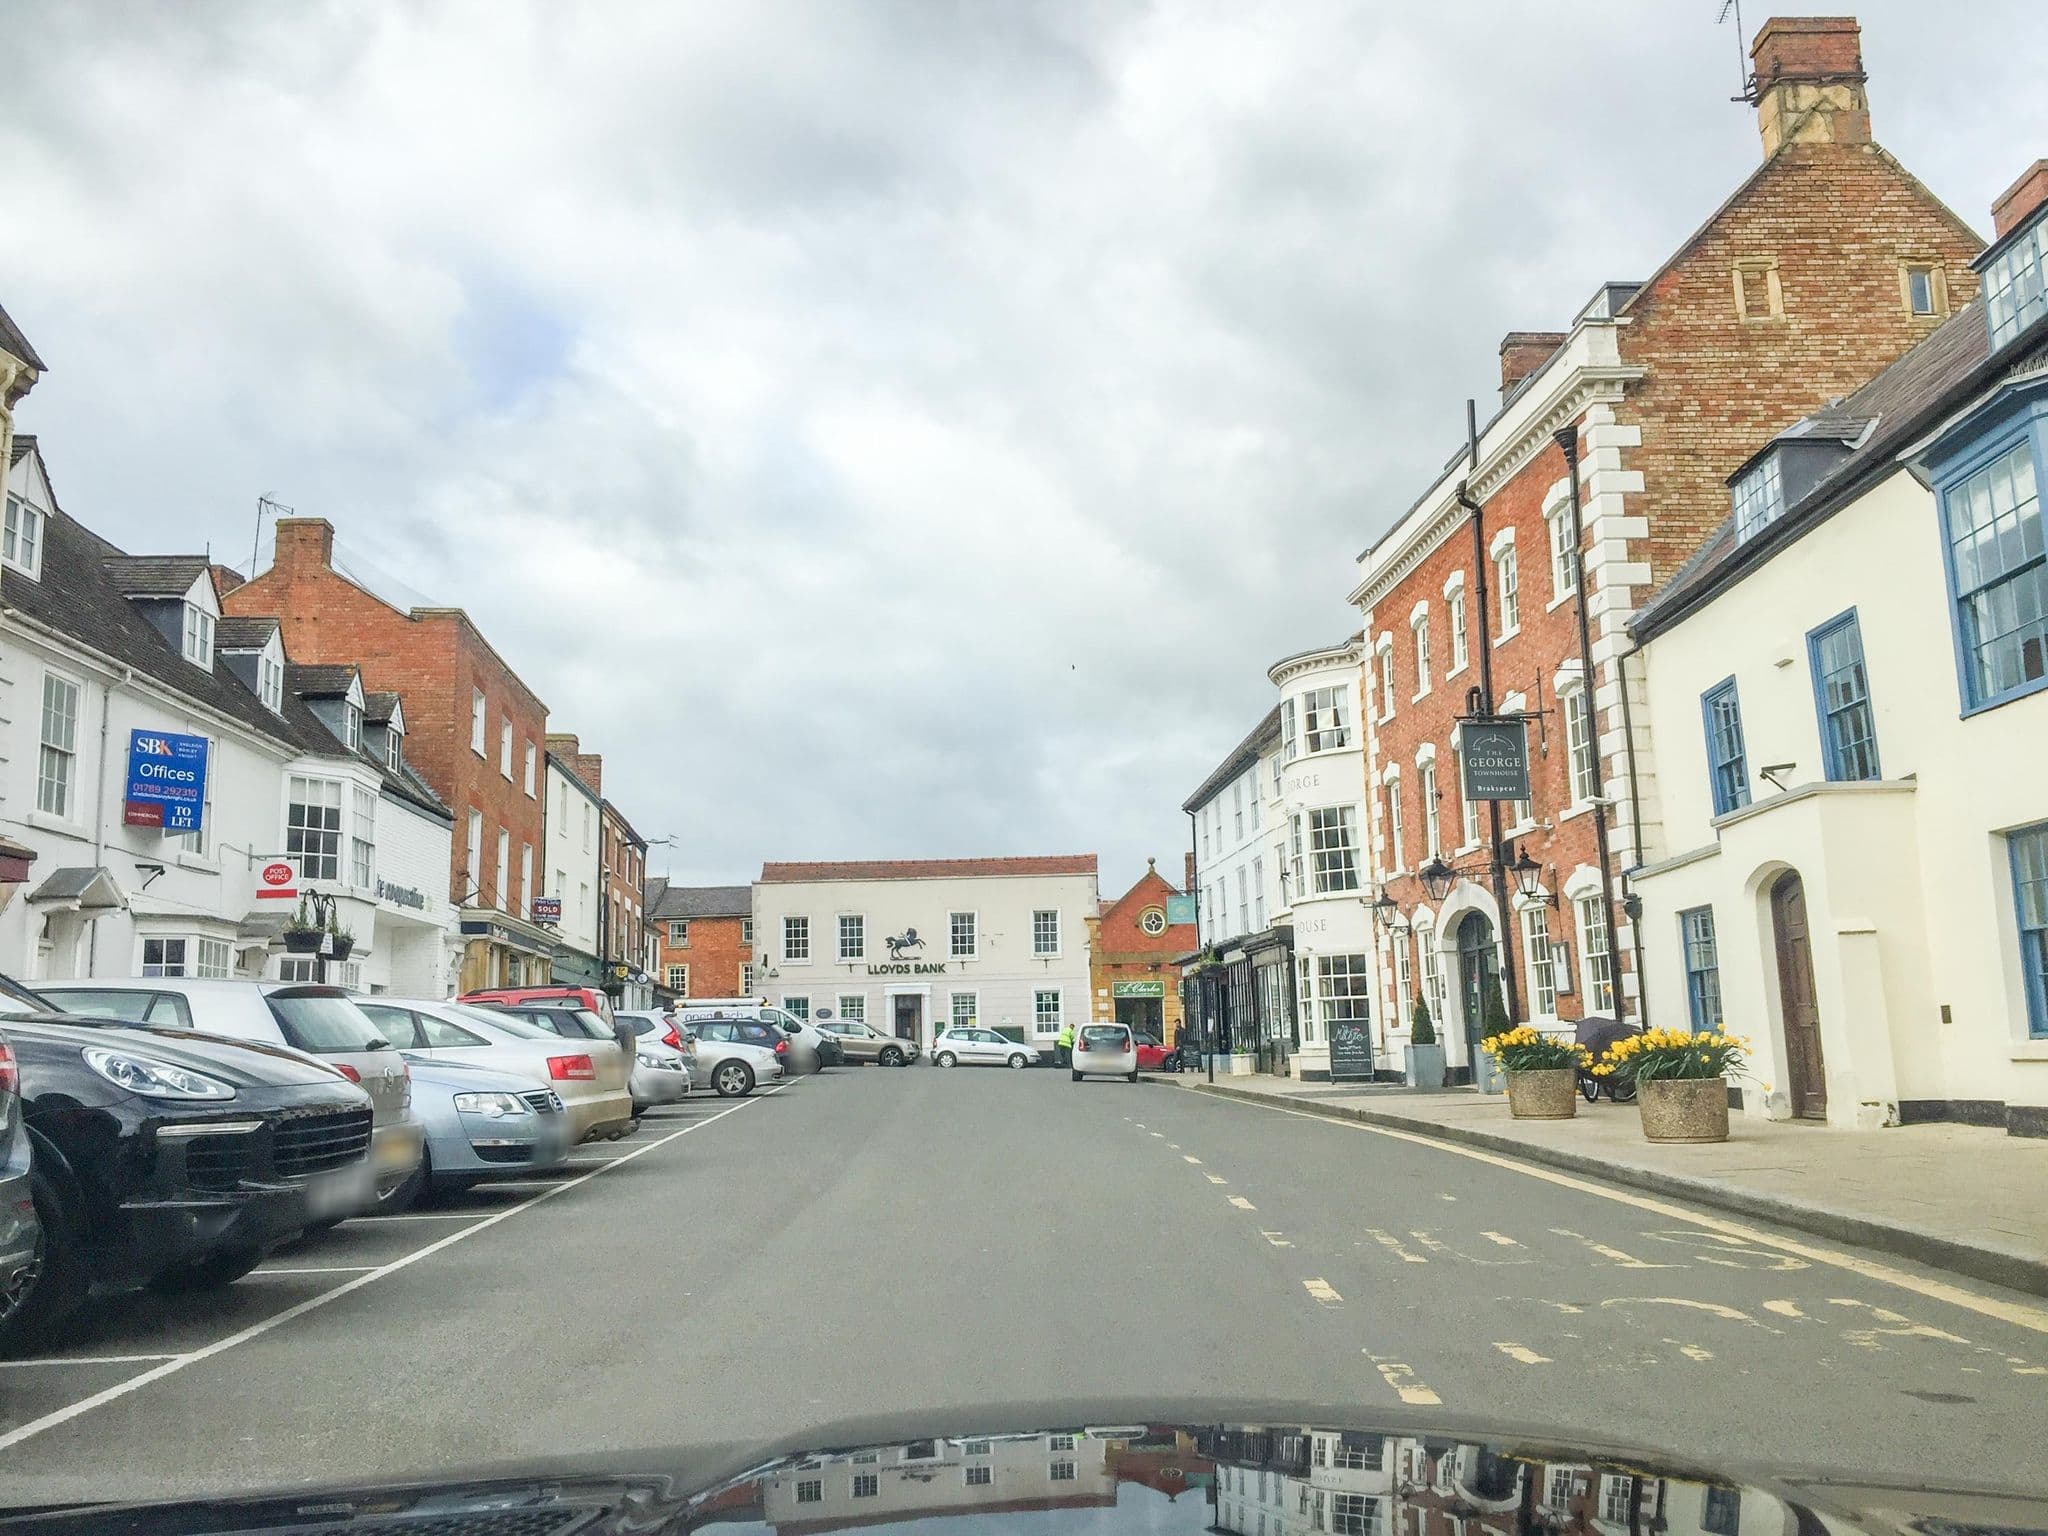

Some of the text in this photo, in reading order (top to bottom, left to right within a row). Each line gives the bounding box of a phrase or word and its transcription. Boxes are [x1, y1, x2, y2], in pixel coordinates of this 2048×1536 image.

[136, 737, 173, 756] SBK
[1469, 758, 1521, 768] GEORGE
[140, 763, 195, 782] Offices
[133, 783, 198, 798] 01789 292310
[174, 806, 192, 817] TO
[171, 816, 194, 828] LET
[265, 873, 290, 881] OFFICE
[269, 867, 288, 875] POST
[537, 905, 559, 913] SOLD
[867, 963, 946, 975] LLOYDS BANK
[685, 1009, 744, 1021] openach
